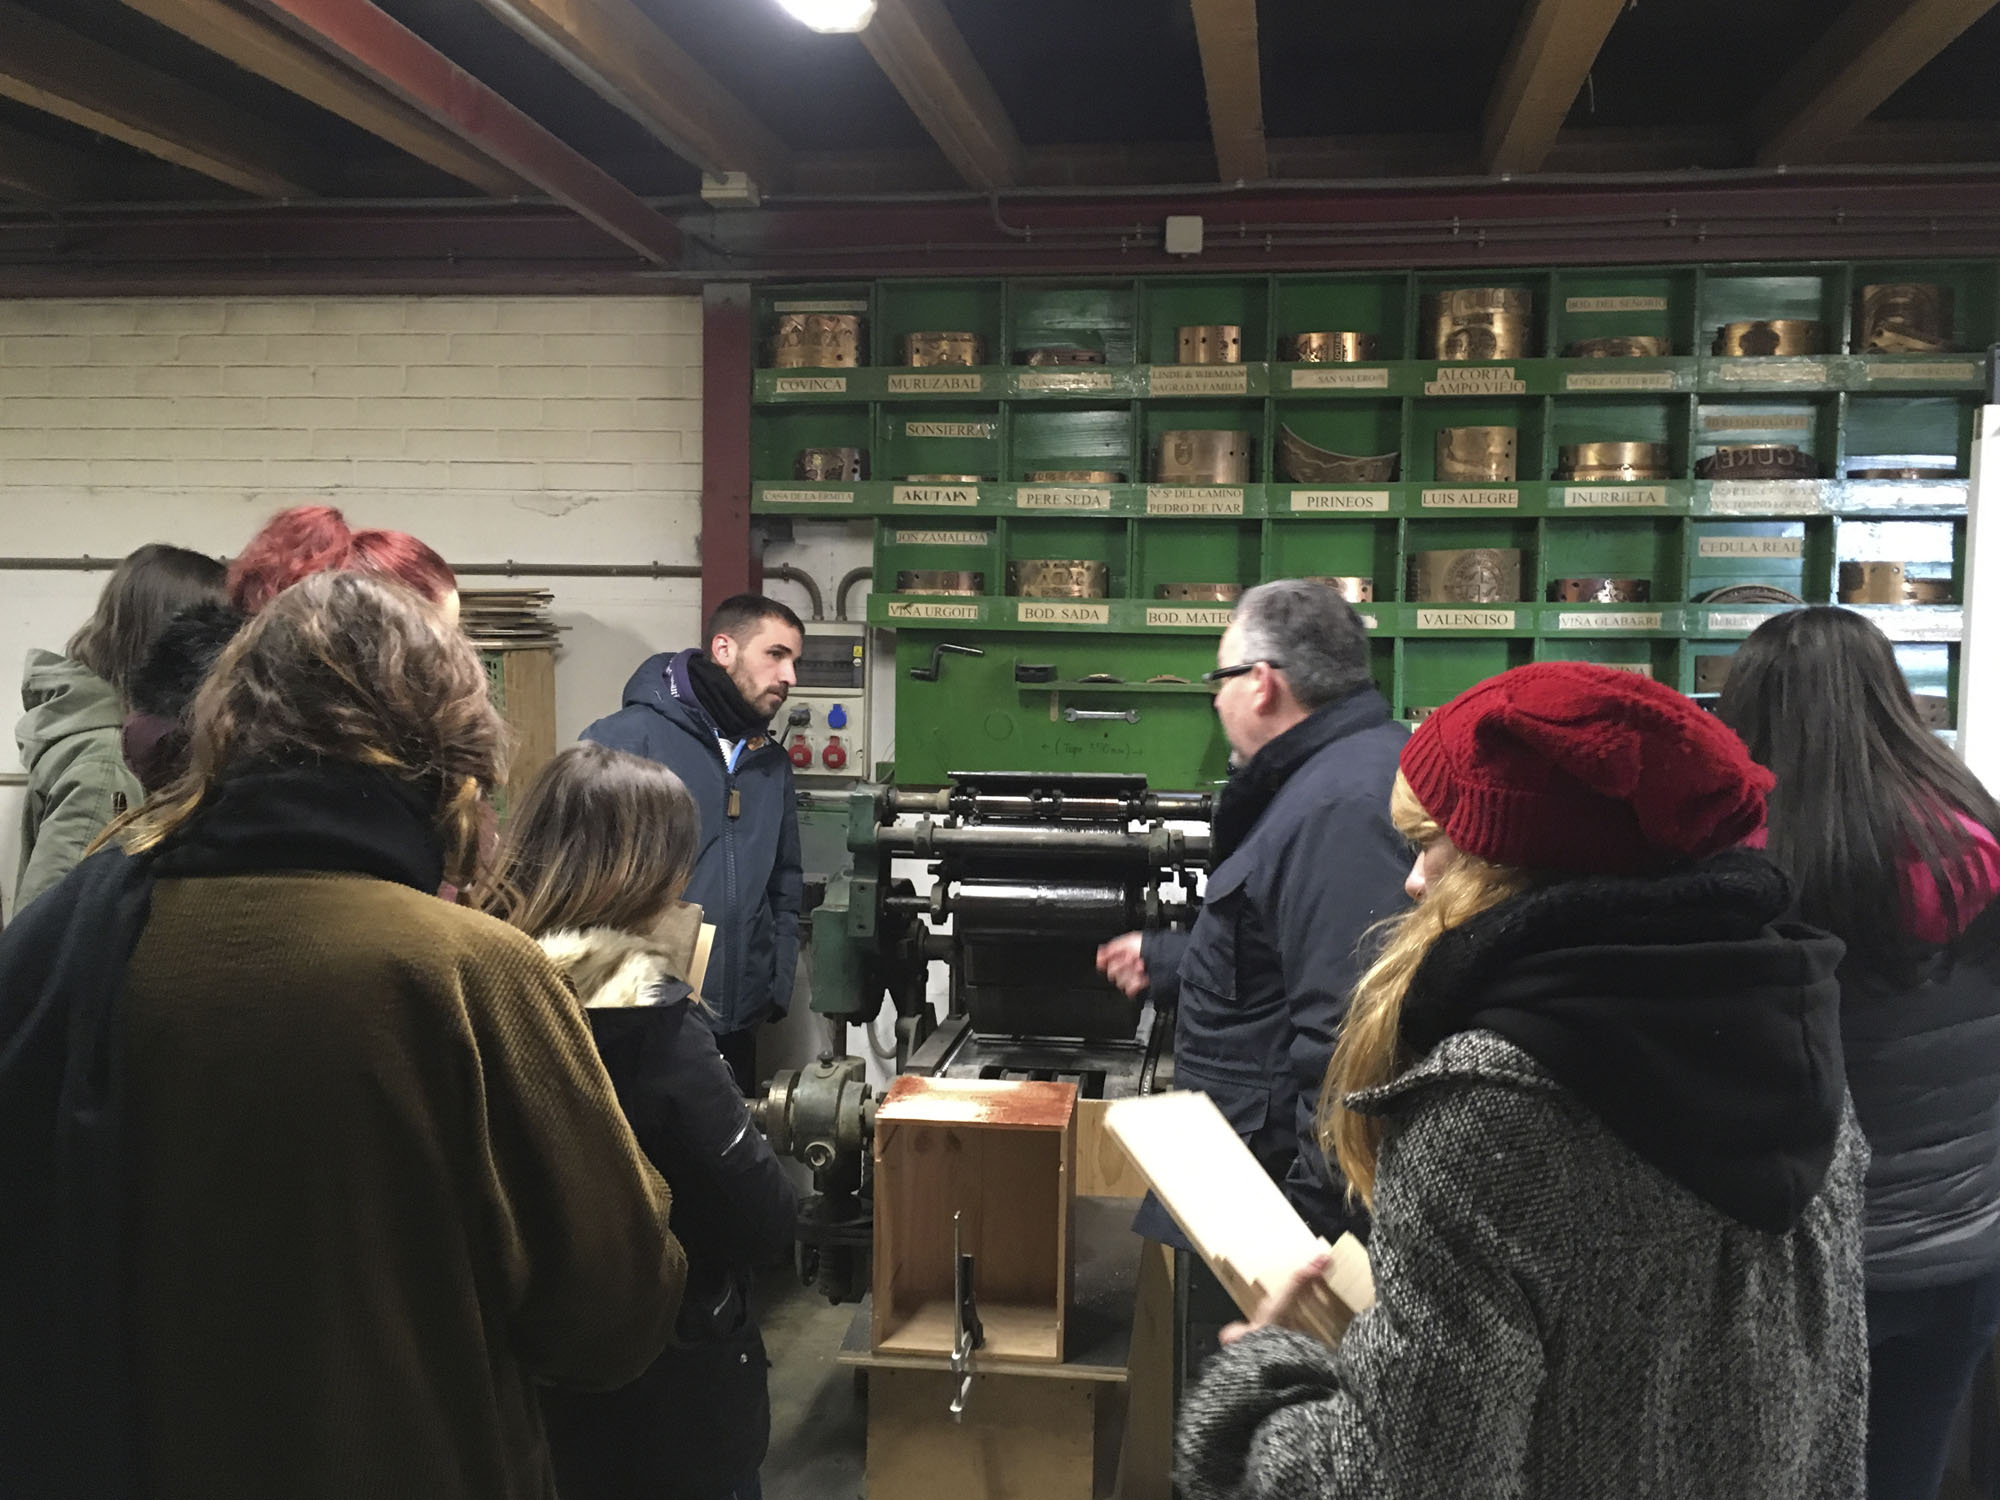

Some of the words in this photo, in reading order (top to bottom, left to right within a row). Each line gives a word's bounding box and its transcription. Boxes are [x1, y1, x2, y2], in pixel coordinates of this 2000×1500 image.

[1318, 375, 1338, 384] SAN
[1339, 374, 1376, 383] VALERO
[1440, 369, 1511, 381] ALCORTA
[780, 379, 842, 391] COVINCA
[890, 378, 979, 390] MURUZABAL
[1152, 383, 1201, 393] SAGRADA
[1203, 382, 1245, 392] FAMILIA
[1427, 382, 1480, 394] CAMPO
[1483, 381, 1525, 393] VIEJO
[907, 423, 985, 436] SONSIERRA
[1026, 493, 1060, 505] PERE
[1064, 494, 1101, 506] SEDA
[1174, 489, 1194, 498] DEL
[1197, 489, 1242, 498] CAMINO
[1423, 492, 1456, 504] LUIS
[1459, 492, 1517, 504] ALEGRE
[1572, 491, 1657, 504] INURRIETA
[1149, 503, 1190, 513] PEDRO
[1192, 503, 1209, 513] DE
[1212, 503, 1242, 513] IVAR
[1306, 496, 1374, 508] PIRINEOS
[897, 532, 918, 542] JON
[921, 532, 986, 543] ZAMALLOA
[1700, 541, 1759, 553] CEDULA
[1762, 541, 1800, 553] REAL
[925, 606, 977, 618] URGOITI
[1061, 608, 1100, 621] SADA
[1149, 612, 1182, 625] BOD.
[1423, 613, 1509, 626] VALENCISO
[1594, 615, 1659, 627] OLABARRI
